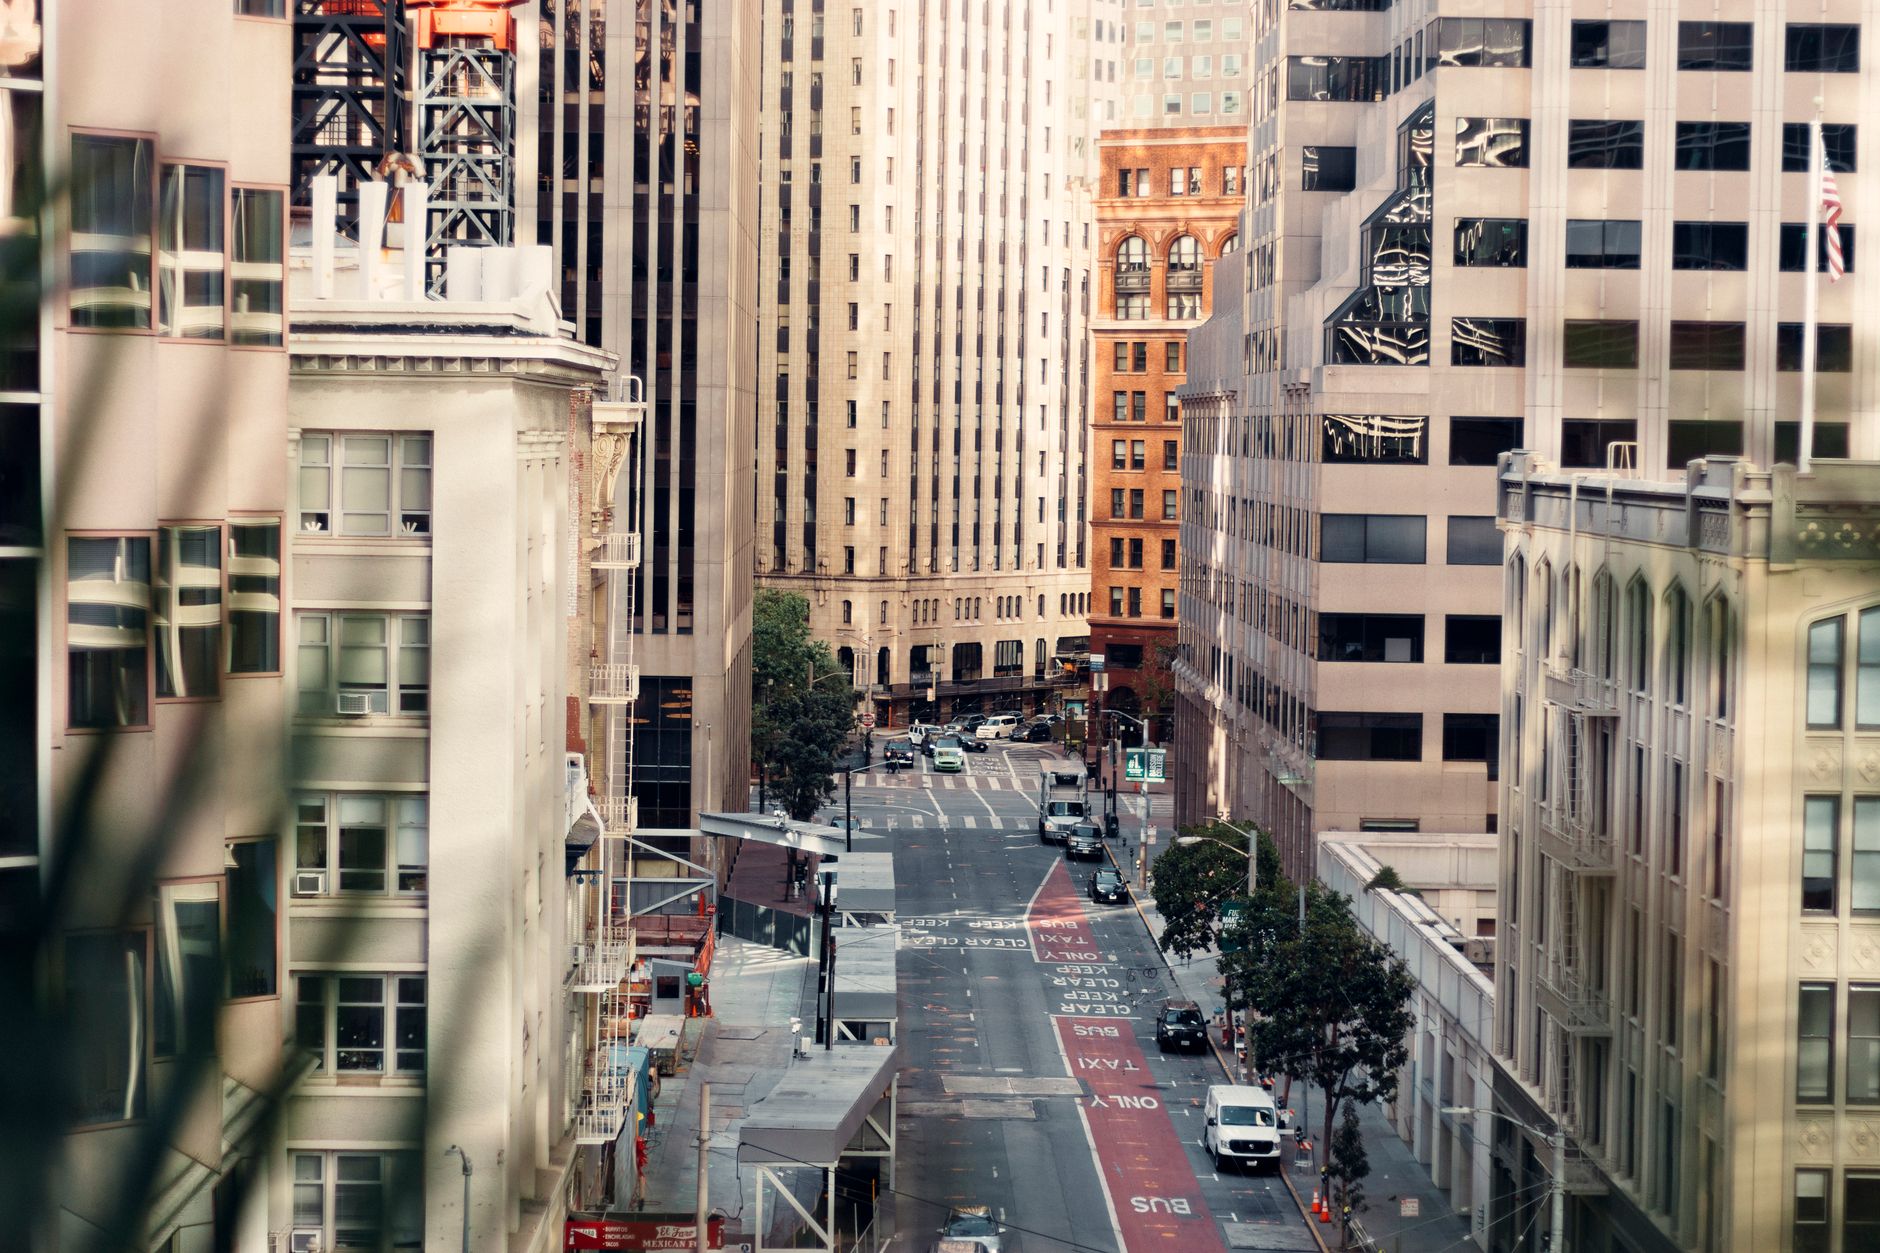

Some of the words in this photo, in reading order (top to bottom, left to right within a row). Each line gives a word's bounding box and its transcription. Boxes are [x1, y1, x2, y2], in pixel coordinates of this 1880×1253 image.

[968, 920, 1018, 929] KEEP
[1040, 920, 1078, 929] BUS
[965, 937, 1027, 948] CLEAR
[1040, 934, 1089, 945] TAXI
[1045, 951, 1098, 961] ONLY
[1056, 965, 1109, 975] KEEP
[1053, 976, 1120, 988] CLEAR
[1063, 990, 1119, 1002] KEEP
[1060, 1002, 1131, 1015] CLEAR
[1073, 1024, 1120, 1038] BUS
[1078, 1057, 1140, 1071] TAXI
[1090, 1094, 1159, 1110] ONLY
[1130, 1196, 1192, 1215] BUS
[660, 1227, 670, 1237] El
[672, 1227, 694, 1239] Faro
[642, 1239, 686, 1248] MEXICAN
